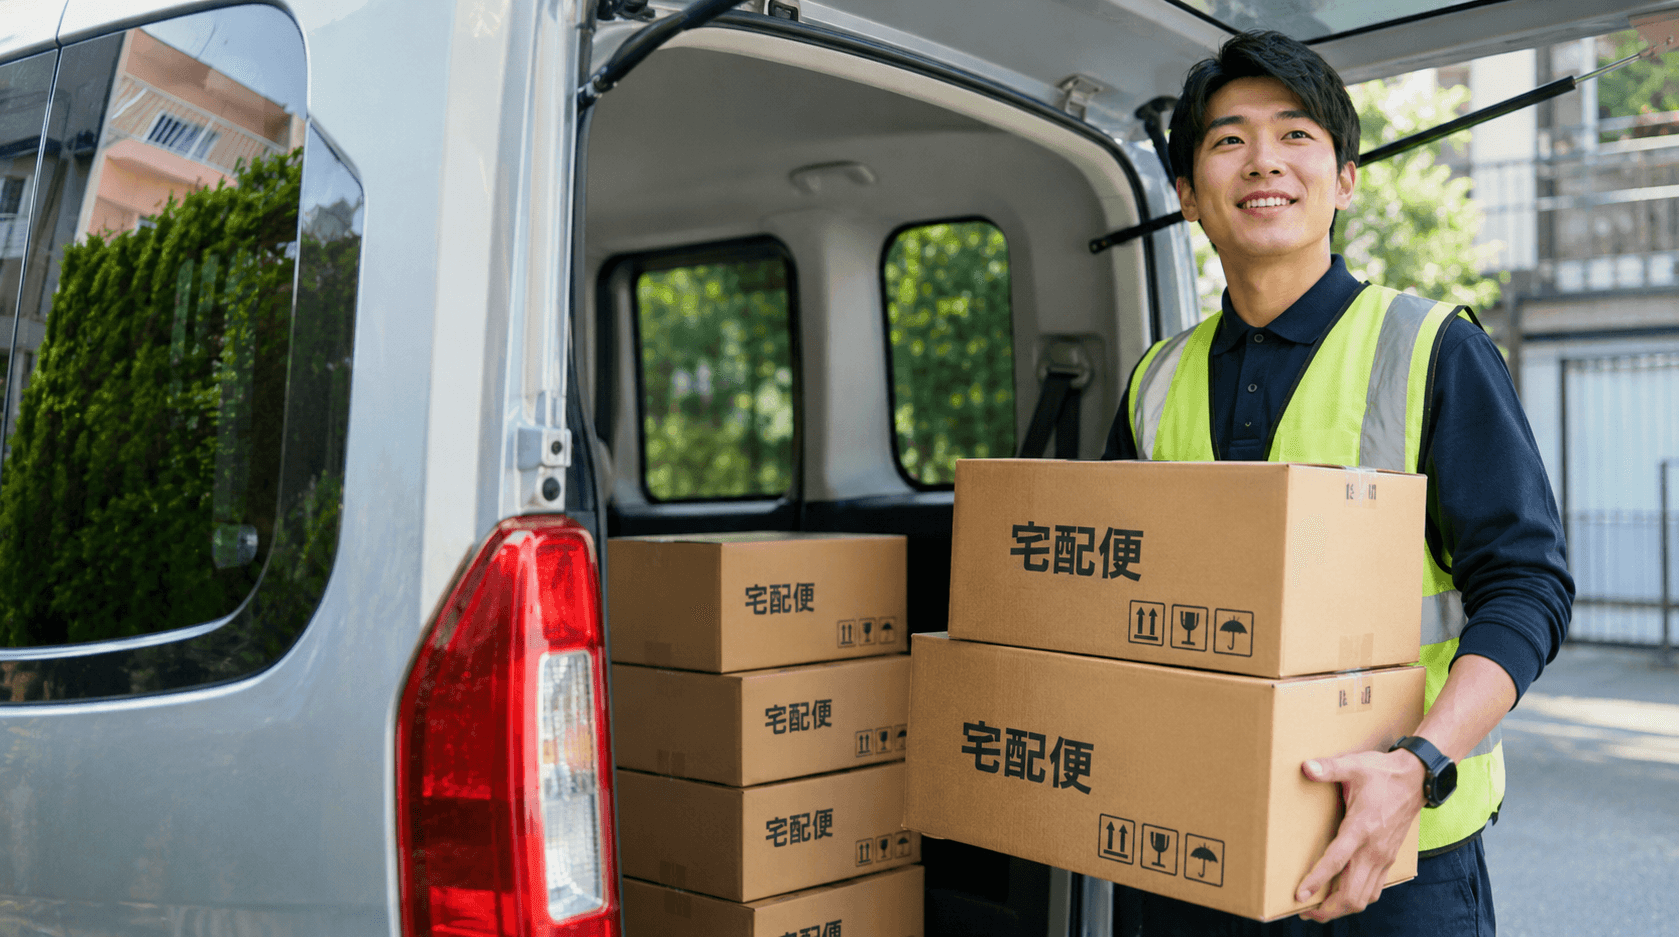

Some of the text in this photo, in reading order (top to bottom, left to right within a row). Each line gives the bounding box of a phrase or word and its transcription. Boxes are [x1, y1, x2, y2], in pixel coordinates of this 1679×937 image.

[1010, 521, 1144, 582] 宅配便
[745, 582, 815, 615] 宅配便
[765, 699, 832, 735] 宅配便
[961, 720, 1095, 795] 宅配便
[766, 808, 833, 848] 宅配便
